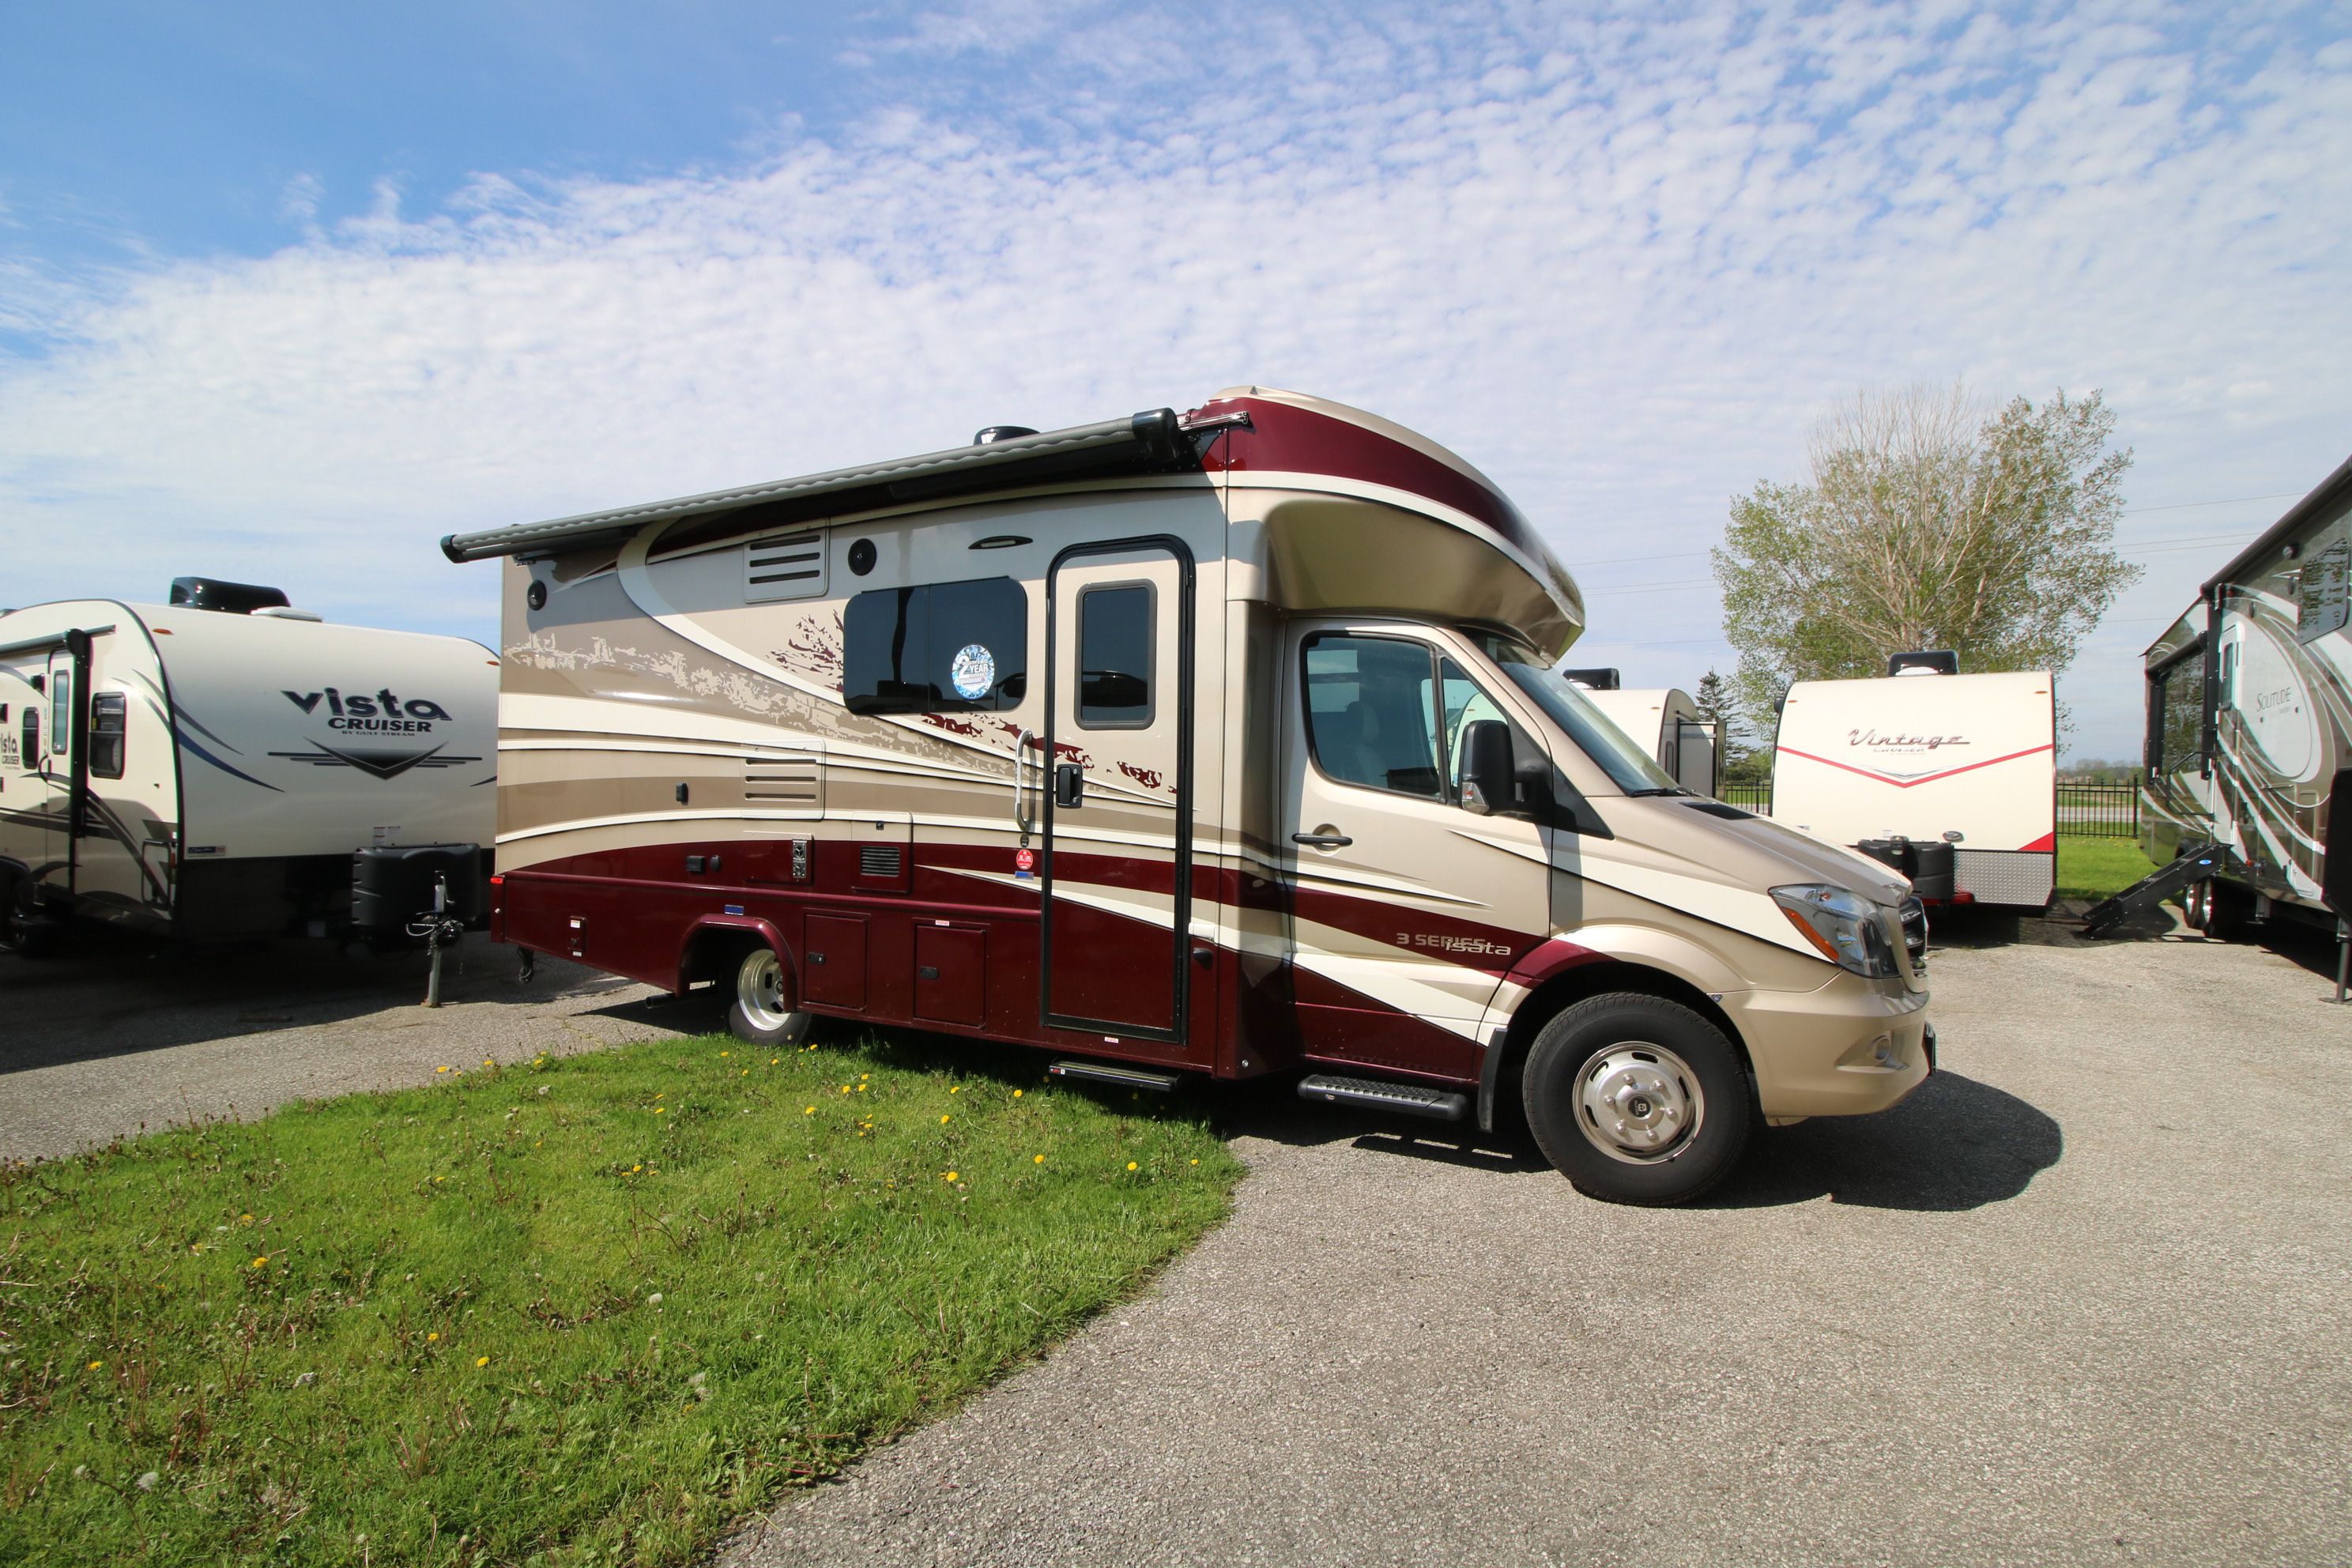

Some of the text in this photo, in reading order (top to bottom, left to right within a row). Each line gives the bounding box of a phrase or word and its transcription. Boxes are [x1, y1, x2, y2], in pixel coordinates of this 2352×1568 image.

[957, 655, 971, 679] 2
[970, 664, 988, 673] YEAR
[327, 718, 432, 733] CRUISER
[0, 733, 18, 754] ista
[1848, 729, 1970, 749] Vintage
[1396, 933, 1410, 944] 3
